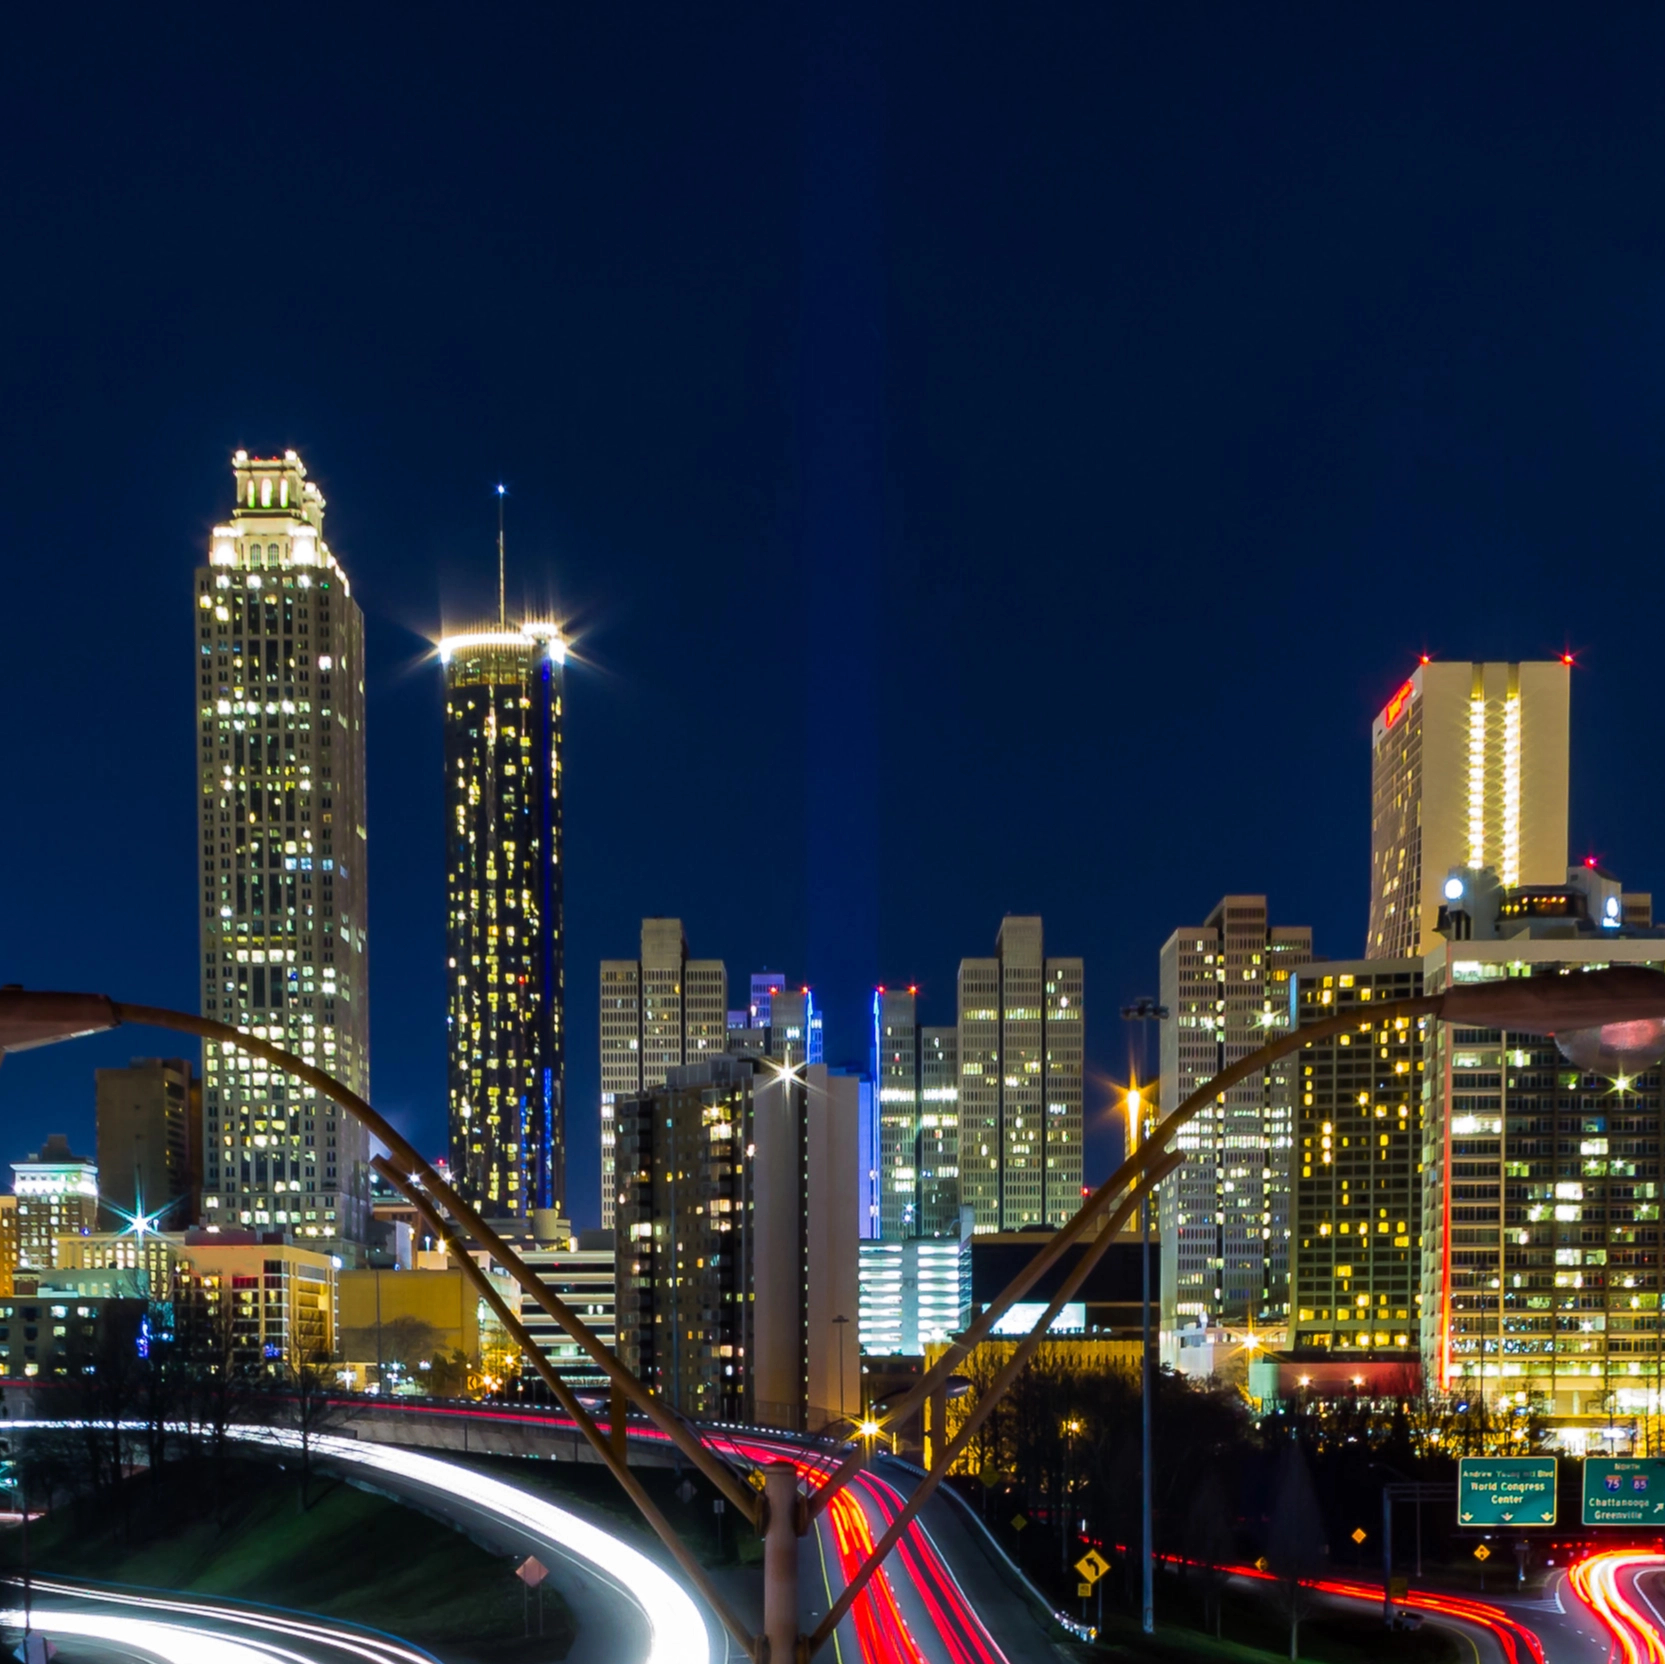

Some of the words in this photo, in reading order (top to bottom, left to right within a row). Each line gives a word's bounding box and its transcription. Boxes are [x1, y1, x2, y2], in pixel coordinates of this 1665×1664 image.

[1471, 1482, 1498, 1491] World
[1500, 1482, 1545, 1494] Congress
[1607, 1480, 1620, 1489] 75
[1633, 1480, 1647, 1490] 85
[1491, 1495, 1524, 1504] Center
[1588, 1498, 1650, 1509] Chattanooga
[1594, 1510, 1643, 1520] Greenville
